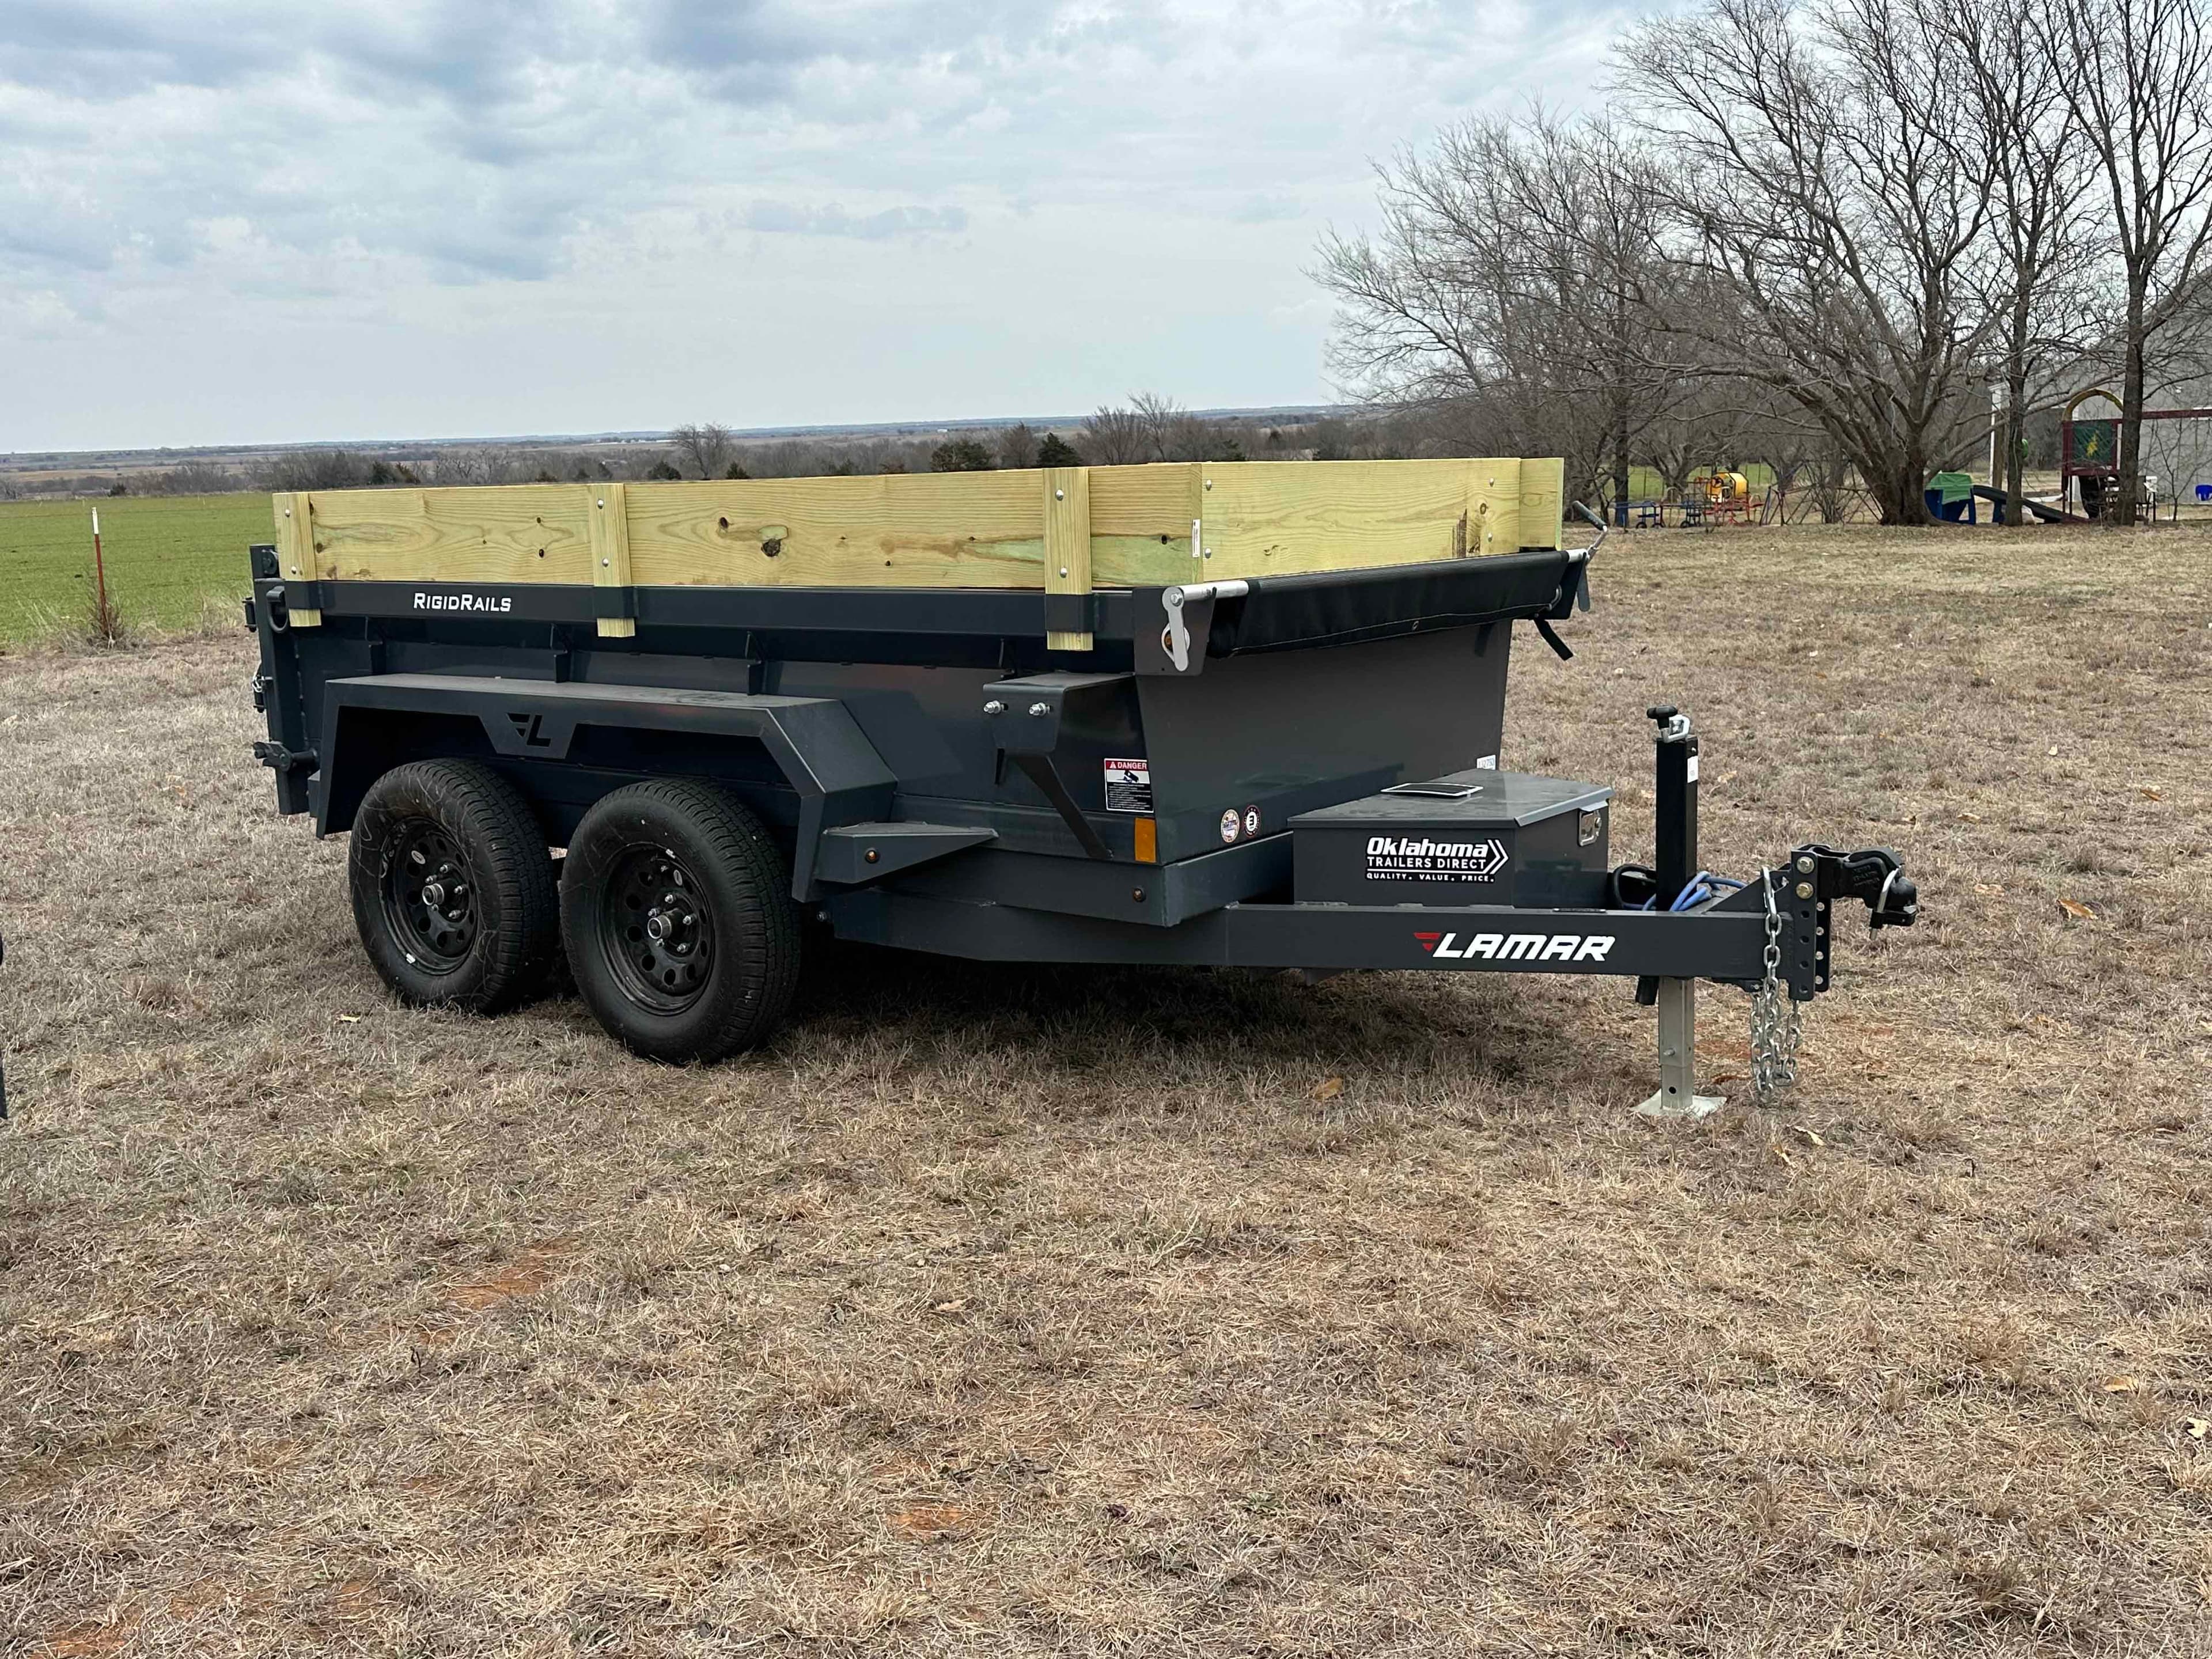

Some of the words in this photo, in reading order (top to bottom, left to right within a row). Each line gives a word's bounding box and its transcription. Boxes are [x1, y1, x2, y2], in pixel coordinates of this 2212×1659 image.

[1118, 762, 1147, 770] DANGER
[1366, 837, 1489, 858] Oklahoma
[1367, 857, 1431, 868] TRAILERS
[1437, 858, 1486, 869] DIRECT
[1432, 933, 1616, 961] LAMAR
